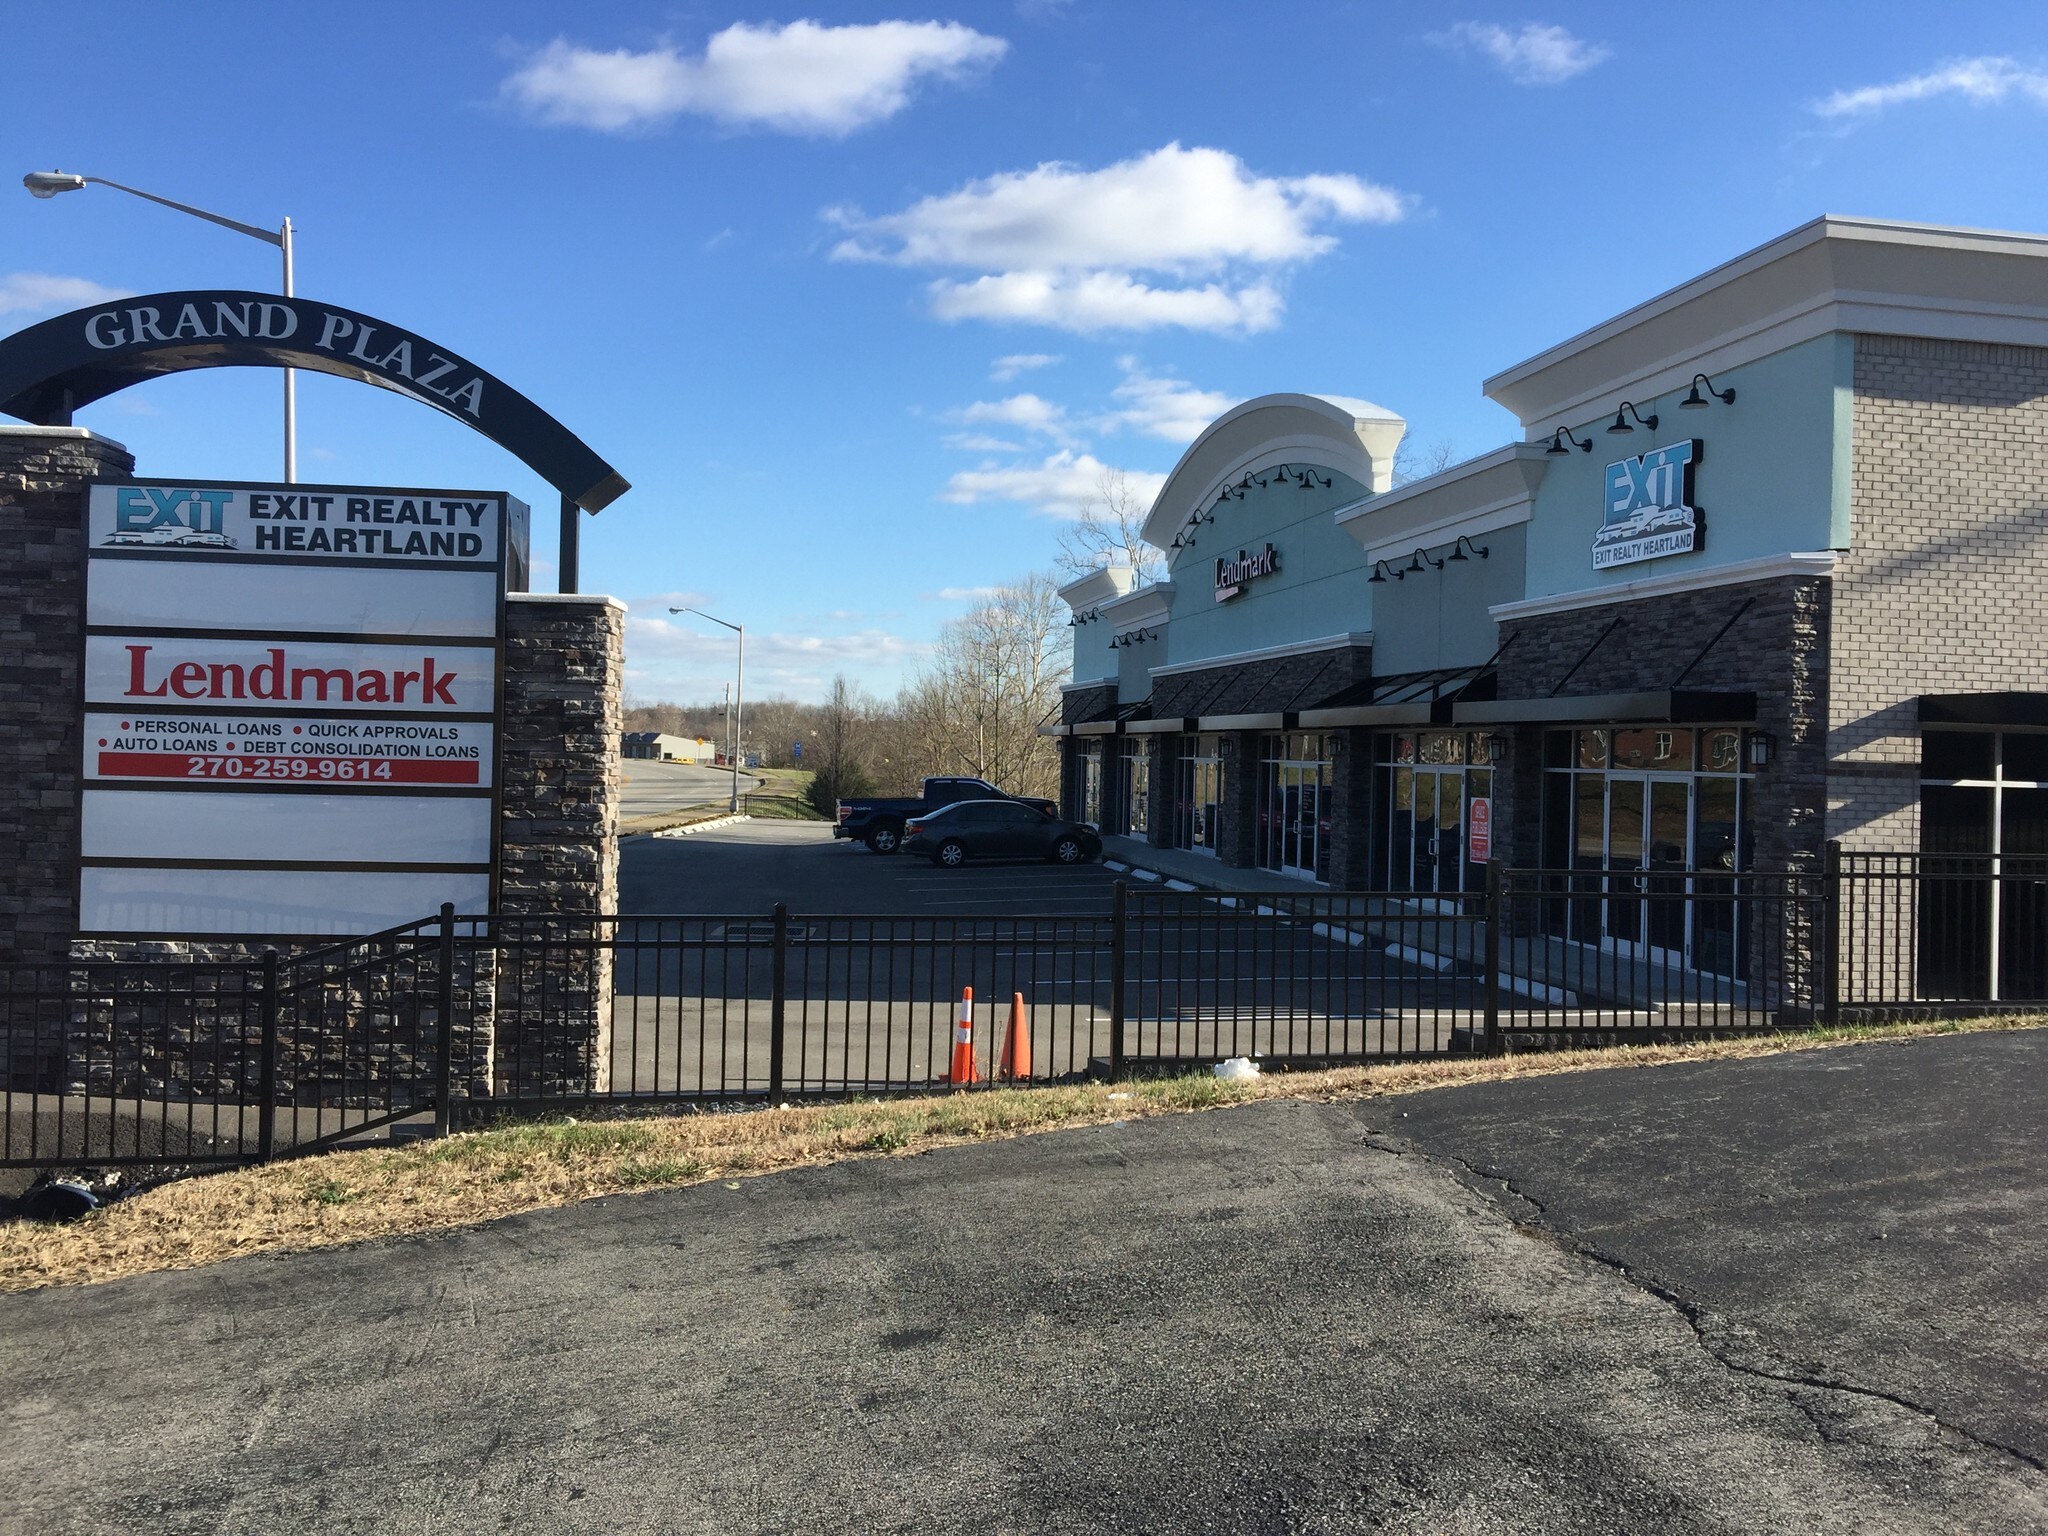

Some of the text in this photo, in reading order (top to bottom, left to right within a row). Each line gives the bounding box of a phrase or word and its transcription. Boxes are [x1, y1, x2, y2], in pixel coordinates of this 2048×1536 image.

[84, 301, 485, 418] GRAND PLAZA
[249, 494, 488, 527] EXIT REALTY
[255, 525, 483, 557] HEARTLAND
[1594, 532, 1692, 565] EXIT REALTY HEARTLAND
[1214, 543, 1276, 588] Lendmark
[123, 645, 458, 705] Lendmark
[134, 720, 282, 736] PERSONAL LOANS
[308, 723, 458, 740] QUICK APPROVALS
[113, 737, 218, 752] AUTO LOANS
[243, 740, 480, 758] DEBT CONSOLIDATION LOANS
[187, 756, 392, 780] 270-259-9614
